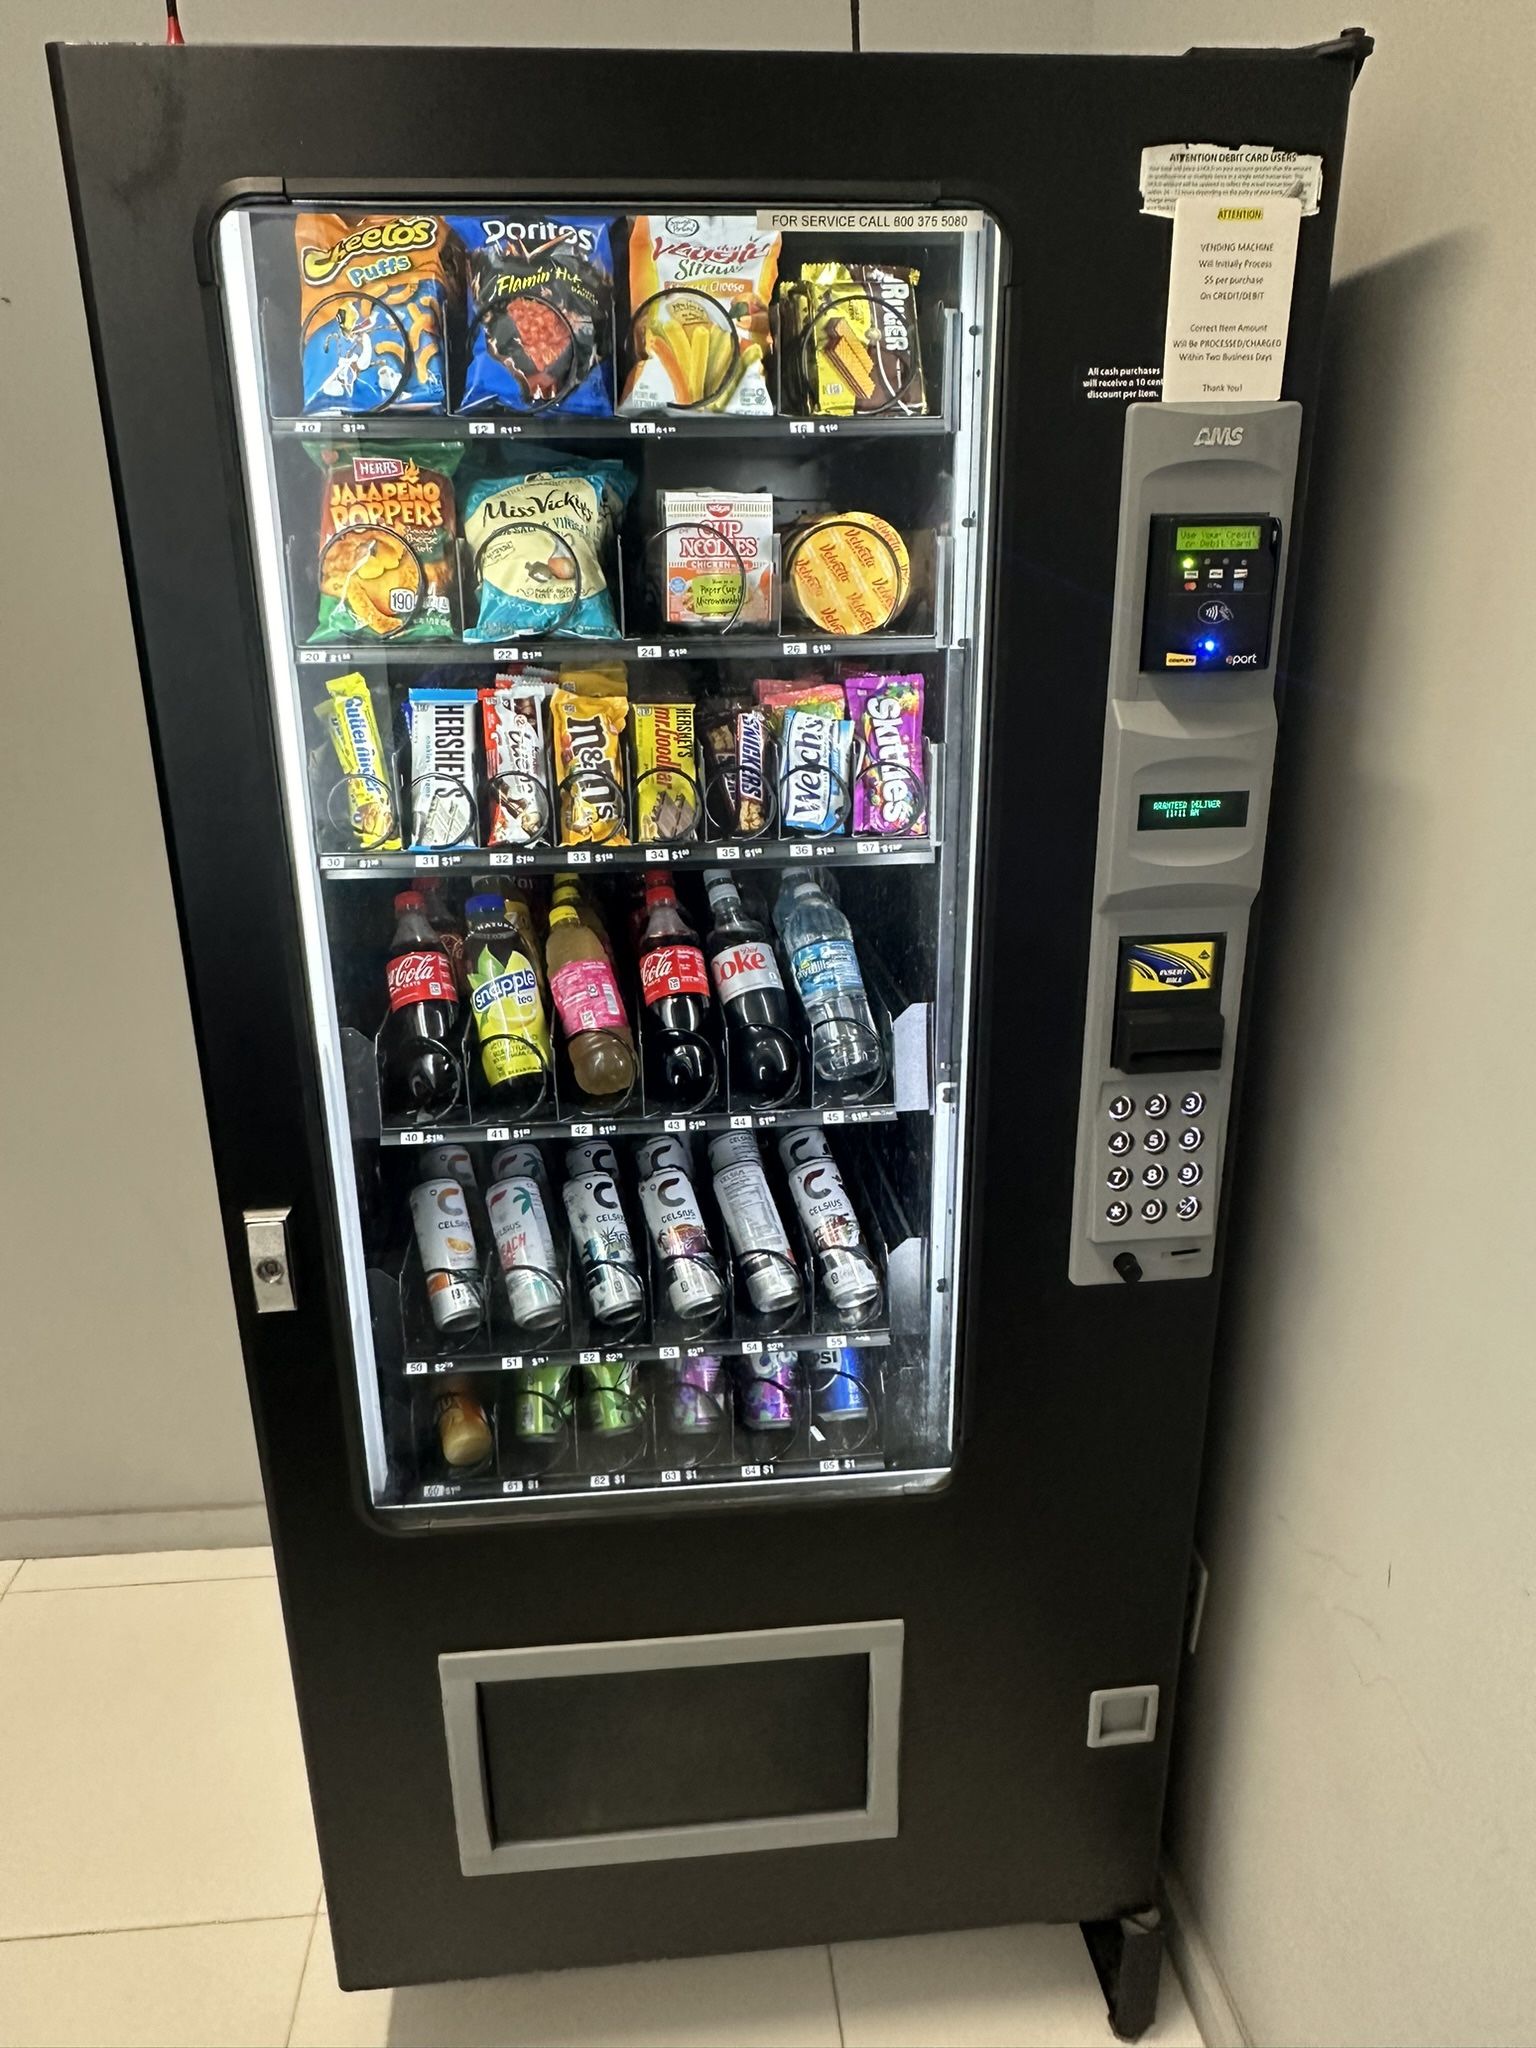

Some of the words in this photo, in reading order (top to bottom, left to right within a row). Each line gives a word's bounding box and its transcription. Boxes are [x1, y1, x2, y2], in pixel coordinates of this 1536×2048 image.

[1218, 153, 1243, 163] DEBIT
[1245, 153, 1269, 163] CARD
[1270, 153, 1297, 163] USERS
[772, 215, 798, 227] FOR
[801, 215, 856, 227] SERVICE
[859, 215, 890, 227] CALL
[894, 215, 914, 227] 800
[941, 215, 968, 227] 5080
[482, 220, 593, 251] Doritos
[1200, 243, 1236, 252] VENDING
[1237, 243, 1274, 252] MACHINE
[1198, 259, 1214, 268] Will
[347, 255, 411, 288] Puffs
[674, 258, 744, 280] Straws
[1215, 276, 1229, 286] per
[1200, 292, 1212, 300] On
[1190, 323, 1218, 333] Correct
[1237, 324, 1268, 333] Amount
[1205, 353, 1221, 361] Two
[1087, 367, 1099, 376] All
[1100, 367, 1119, 376] cash
[1119, 366, 1160, 377] purchases
[1082, 379, 1098, 388] will
[1098, 379, 1128, 387] receive
[1202, 383, 1225, 393] Thank
[1086, 390, 1122, 399] discount
[1122, 390, 1137, 400] per
[1193, 427, 1245, 447] AMS
[330, 499, 444, 534] POPPERS
[483, 499, 536, 528] Miss
[698, 519, 743, 540] CUP
[1181, 531, 1197, 540] Use
[1226, 530, 1257, 540] Credit
[679, 536, 758, 558] NOODLES
[844, 528, 876, 569] Velveeta
[1200, 540, 1225, 548] Debit
[691, 560, 731, 569] CHICKEN
[819, 543, 850, 584] Velveeta
[392, 592, 413, 611] 190
[641, 648, 657, 657] 24
[676, 708, 694, 759] HERSHEY'S
[434, 705, 465, 798] HERSHEY'S
[741, 714, 762, 800] SNICKERS
[867, 697, 912, 823] Skittles
[793, 717, 825, 817] Welch's
[796, 846, 809, 855] 36
[862, 843, 875, 852] 37
[573, 852, 587, 861] 33
[651, 850, 664, 859] 34
[722, 848, 736, 858] 35
[327, 857, 341, 867] 30
[423, 856, 435, 865] 31
[496, 855, 509, 864] 32
[395, 954, 436, 987] Cola
[642, 949, 674, 986] Cola
[475, 968, 536, 1008] snapple
[518, 994, 533, 1005] tea
[1115, 1101, 1123, 1114] 1
[1150, 1099, 1161, 1111] 2
[1185, 1097, 1196, 1109] 3
[733, 1117, 747, 1126] 44
[826, 1112, 839, 1121] 45
[575, 1125, 588, 1134] 42
[667, 1121, 680, 1130] 43
[405, 1133, 417, 1143] 40
[491, 1130, 504, 1139] 41
[1184, 1133, 1194, 1145] 6
[1113, 1136, 1124, 1148] 4
[1148, 1134, 1159, 1147] 5
[1112, 1171, 1123, 1183] 7
[1146, 1169, 1158, 1181] 8
[1182, 1167, 1193, 1179] 9
[808, 1199, 843, 1217] CELSIUS
[1146, 1204, 1156, 1215] 0
[661, 1208, 697, 1224] CELSIUS
[831, 1337, 843, 1346] 55
[746, 1342, 758, 1352] 54
[583, 1353, 595, 1362] 52
[664, 1348, 676, 1357] 53
[506, 1358, 518, 1367] 51
[844, 1459, 856, 1469] $1
[664, 1472, 677, 1480] 63
[685, 1470, 697, 1480] $1
[744, 1466, 756, 1475] 64
[762, 1465, 774, 1475] $1
[594, 1476, 606, 1485] 62
[614, 1475, 626, 1485] $1
